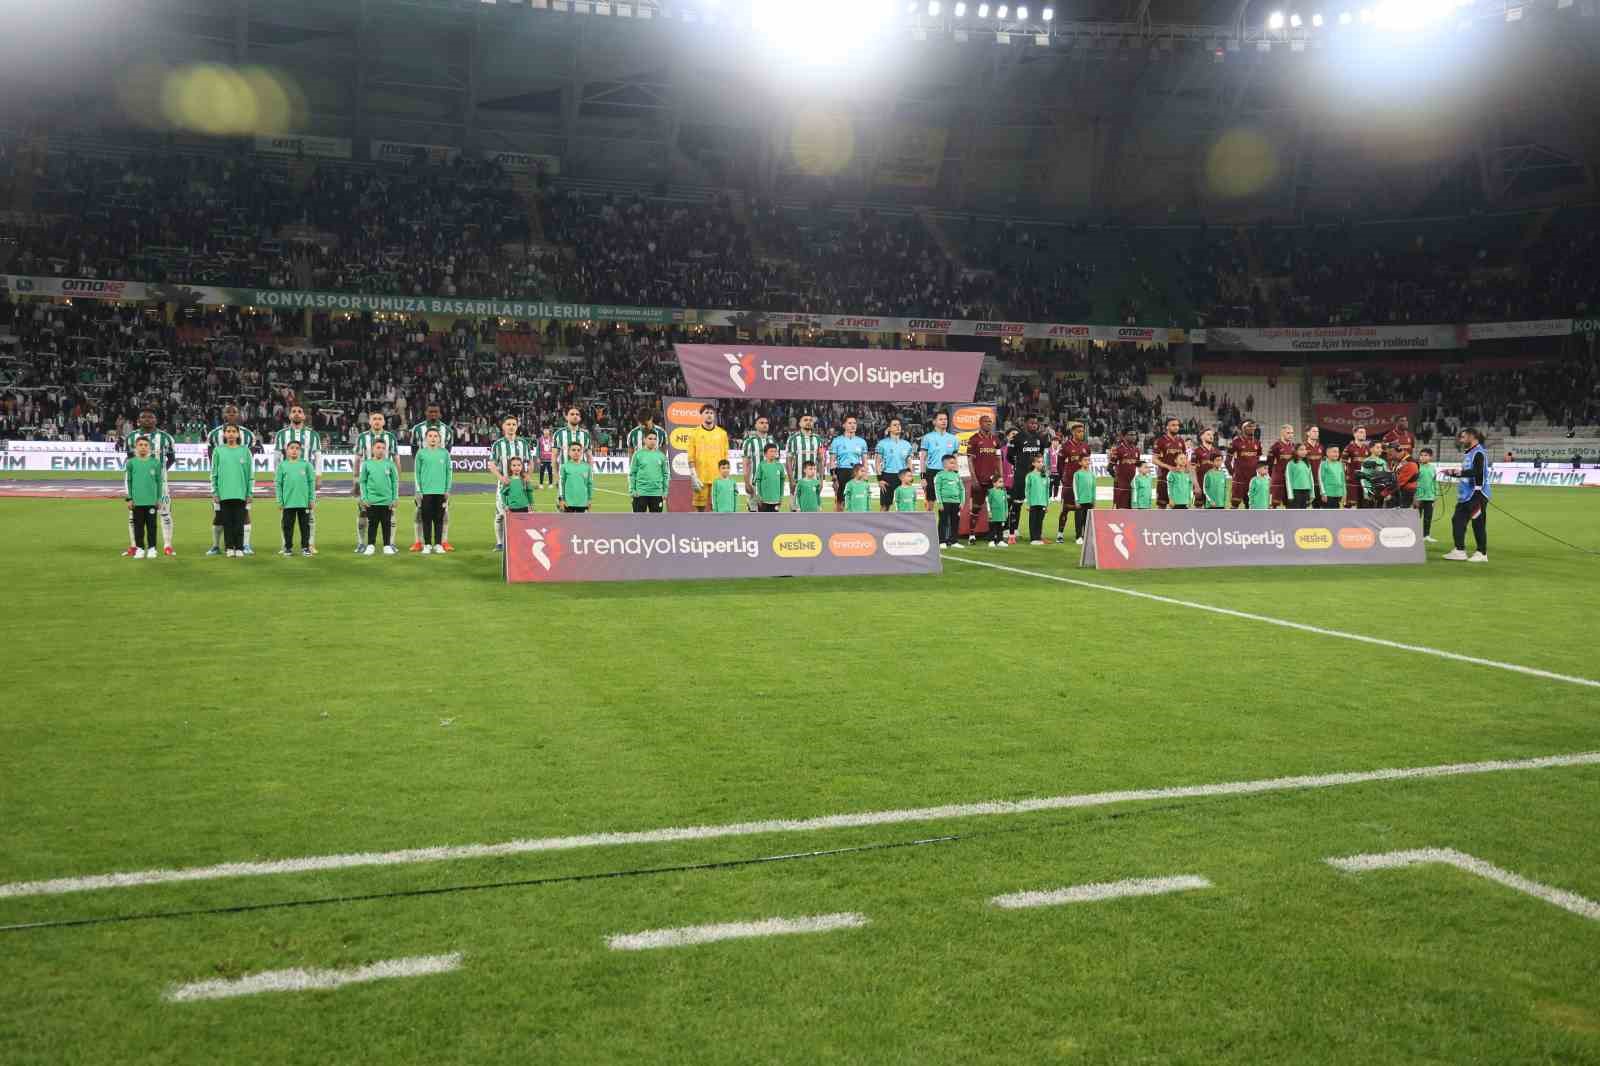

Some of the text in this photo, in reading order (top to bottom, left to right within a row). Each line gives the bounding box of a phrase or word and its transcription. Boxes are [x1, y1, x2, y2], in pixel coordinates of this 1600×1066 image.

[255, 292, 591, 319] KONYASPOR'UMUZA BAŞARILAR DİLERİM
[762, 361, 945, 389] trendyol SüperLig
[571, 534, 676, 559] trendyol
[679, 536, 760, 558] SüperLig
[1143, 528, 1222, 550] trendyol
[1224, 530, 1286, 549] SüperLig
